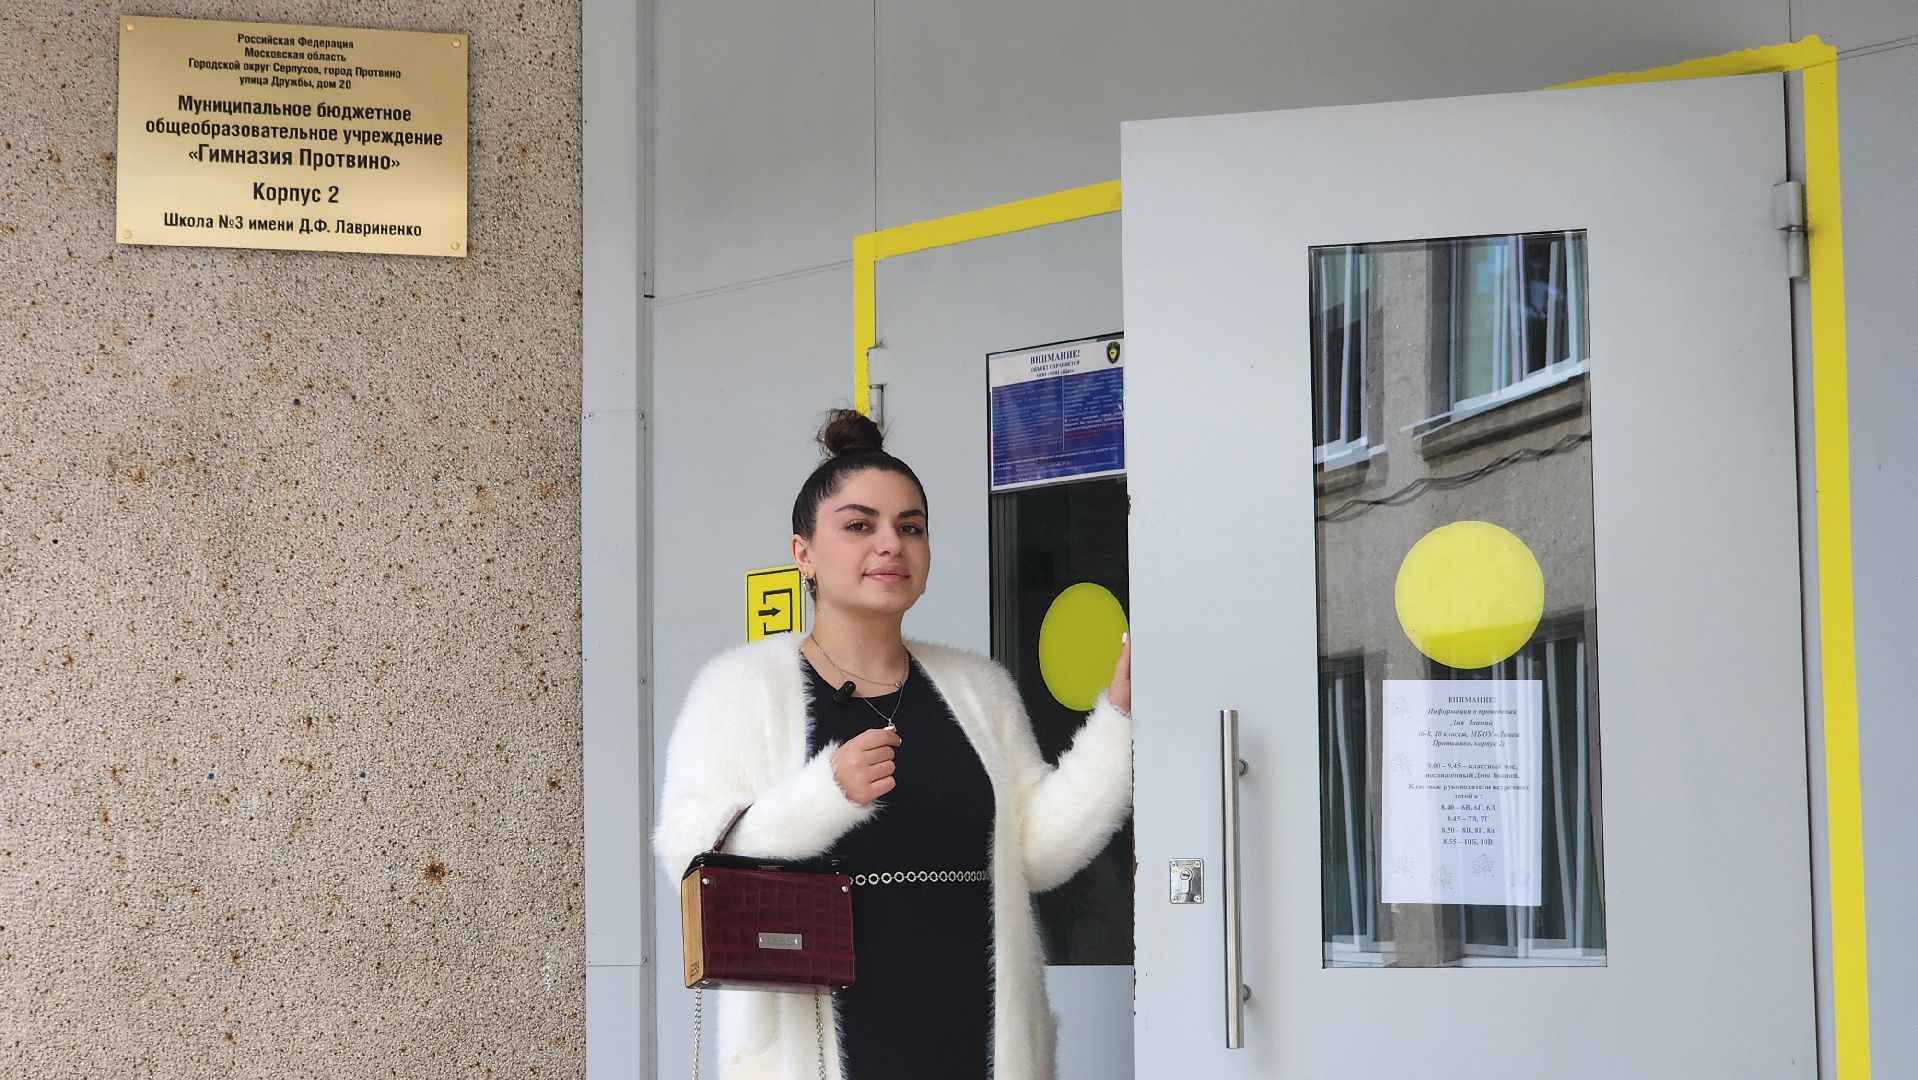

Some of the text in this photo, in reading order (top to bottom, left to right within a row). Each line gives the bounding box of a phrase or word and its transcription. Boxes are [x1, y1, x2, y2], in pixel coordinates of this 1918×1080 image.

[238, 33, 353, 49] Российская Федерация
[245, 48, 346, 62] Московская область
[189, 58, 401, 79] Городской округ Серпухов, город Протвино
[239, 76, 352, 90] улица Дружбы, дом 20
[178, 95, 411, 122] Муниципальное бюджетное
[146, 118, 443, 146] общеобразовательное учреждение
[189, 144, 400, 171] «Гимназия Протвино»
[253, 182, 339, 206] Корпус 2
[164, 212, 422, 237] Школа №3 имени Д.Ф. Лавриненко
[1030, 350, 1080, 365] ВНИМАНИЕ!
